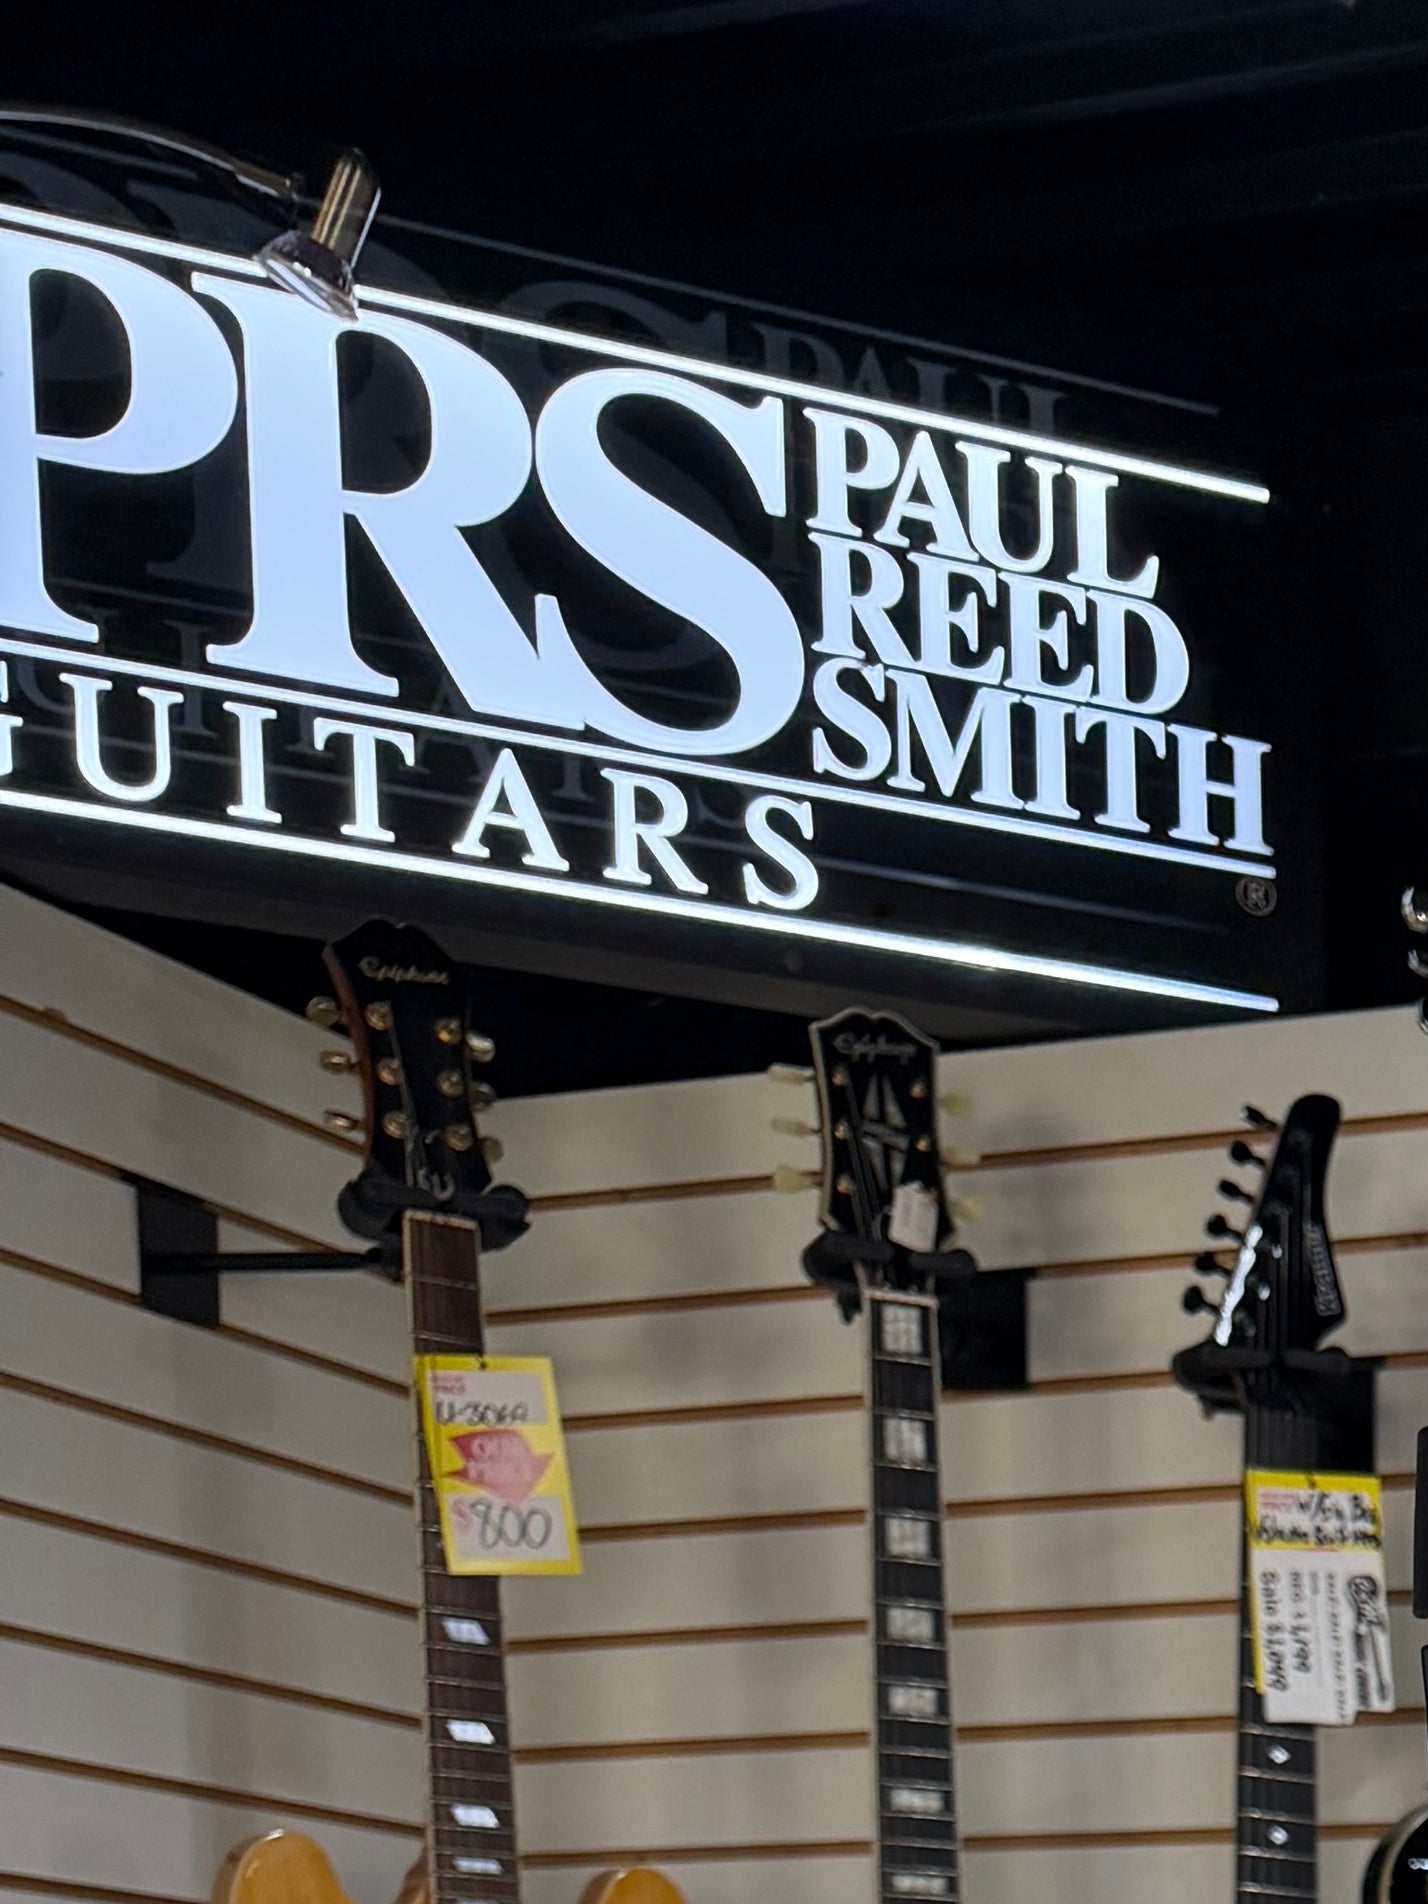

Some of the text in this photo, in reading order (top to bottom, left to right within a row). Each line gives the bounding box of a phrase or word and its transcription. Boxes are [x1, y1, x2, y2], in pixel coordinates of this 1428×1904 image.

[0, 232, 805, 758] PRS
[803, 406, 1159, 600] PAUL
[806, 531, 1191, 718] REED
[0, 658, 821, 912] UITARS
[811, 658, 1273, 858] SMITH
